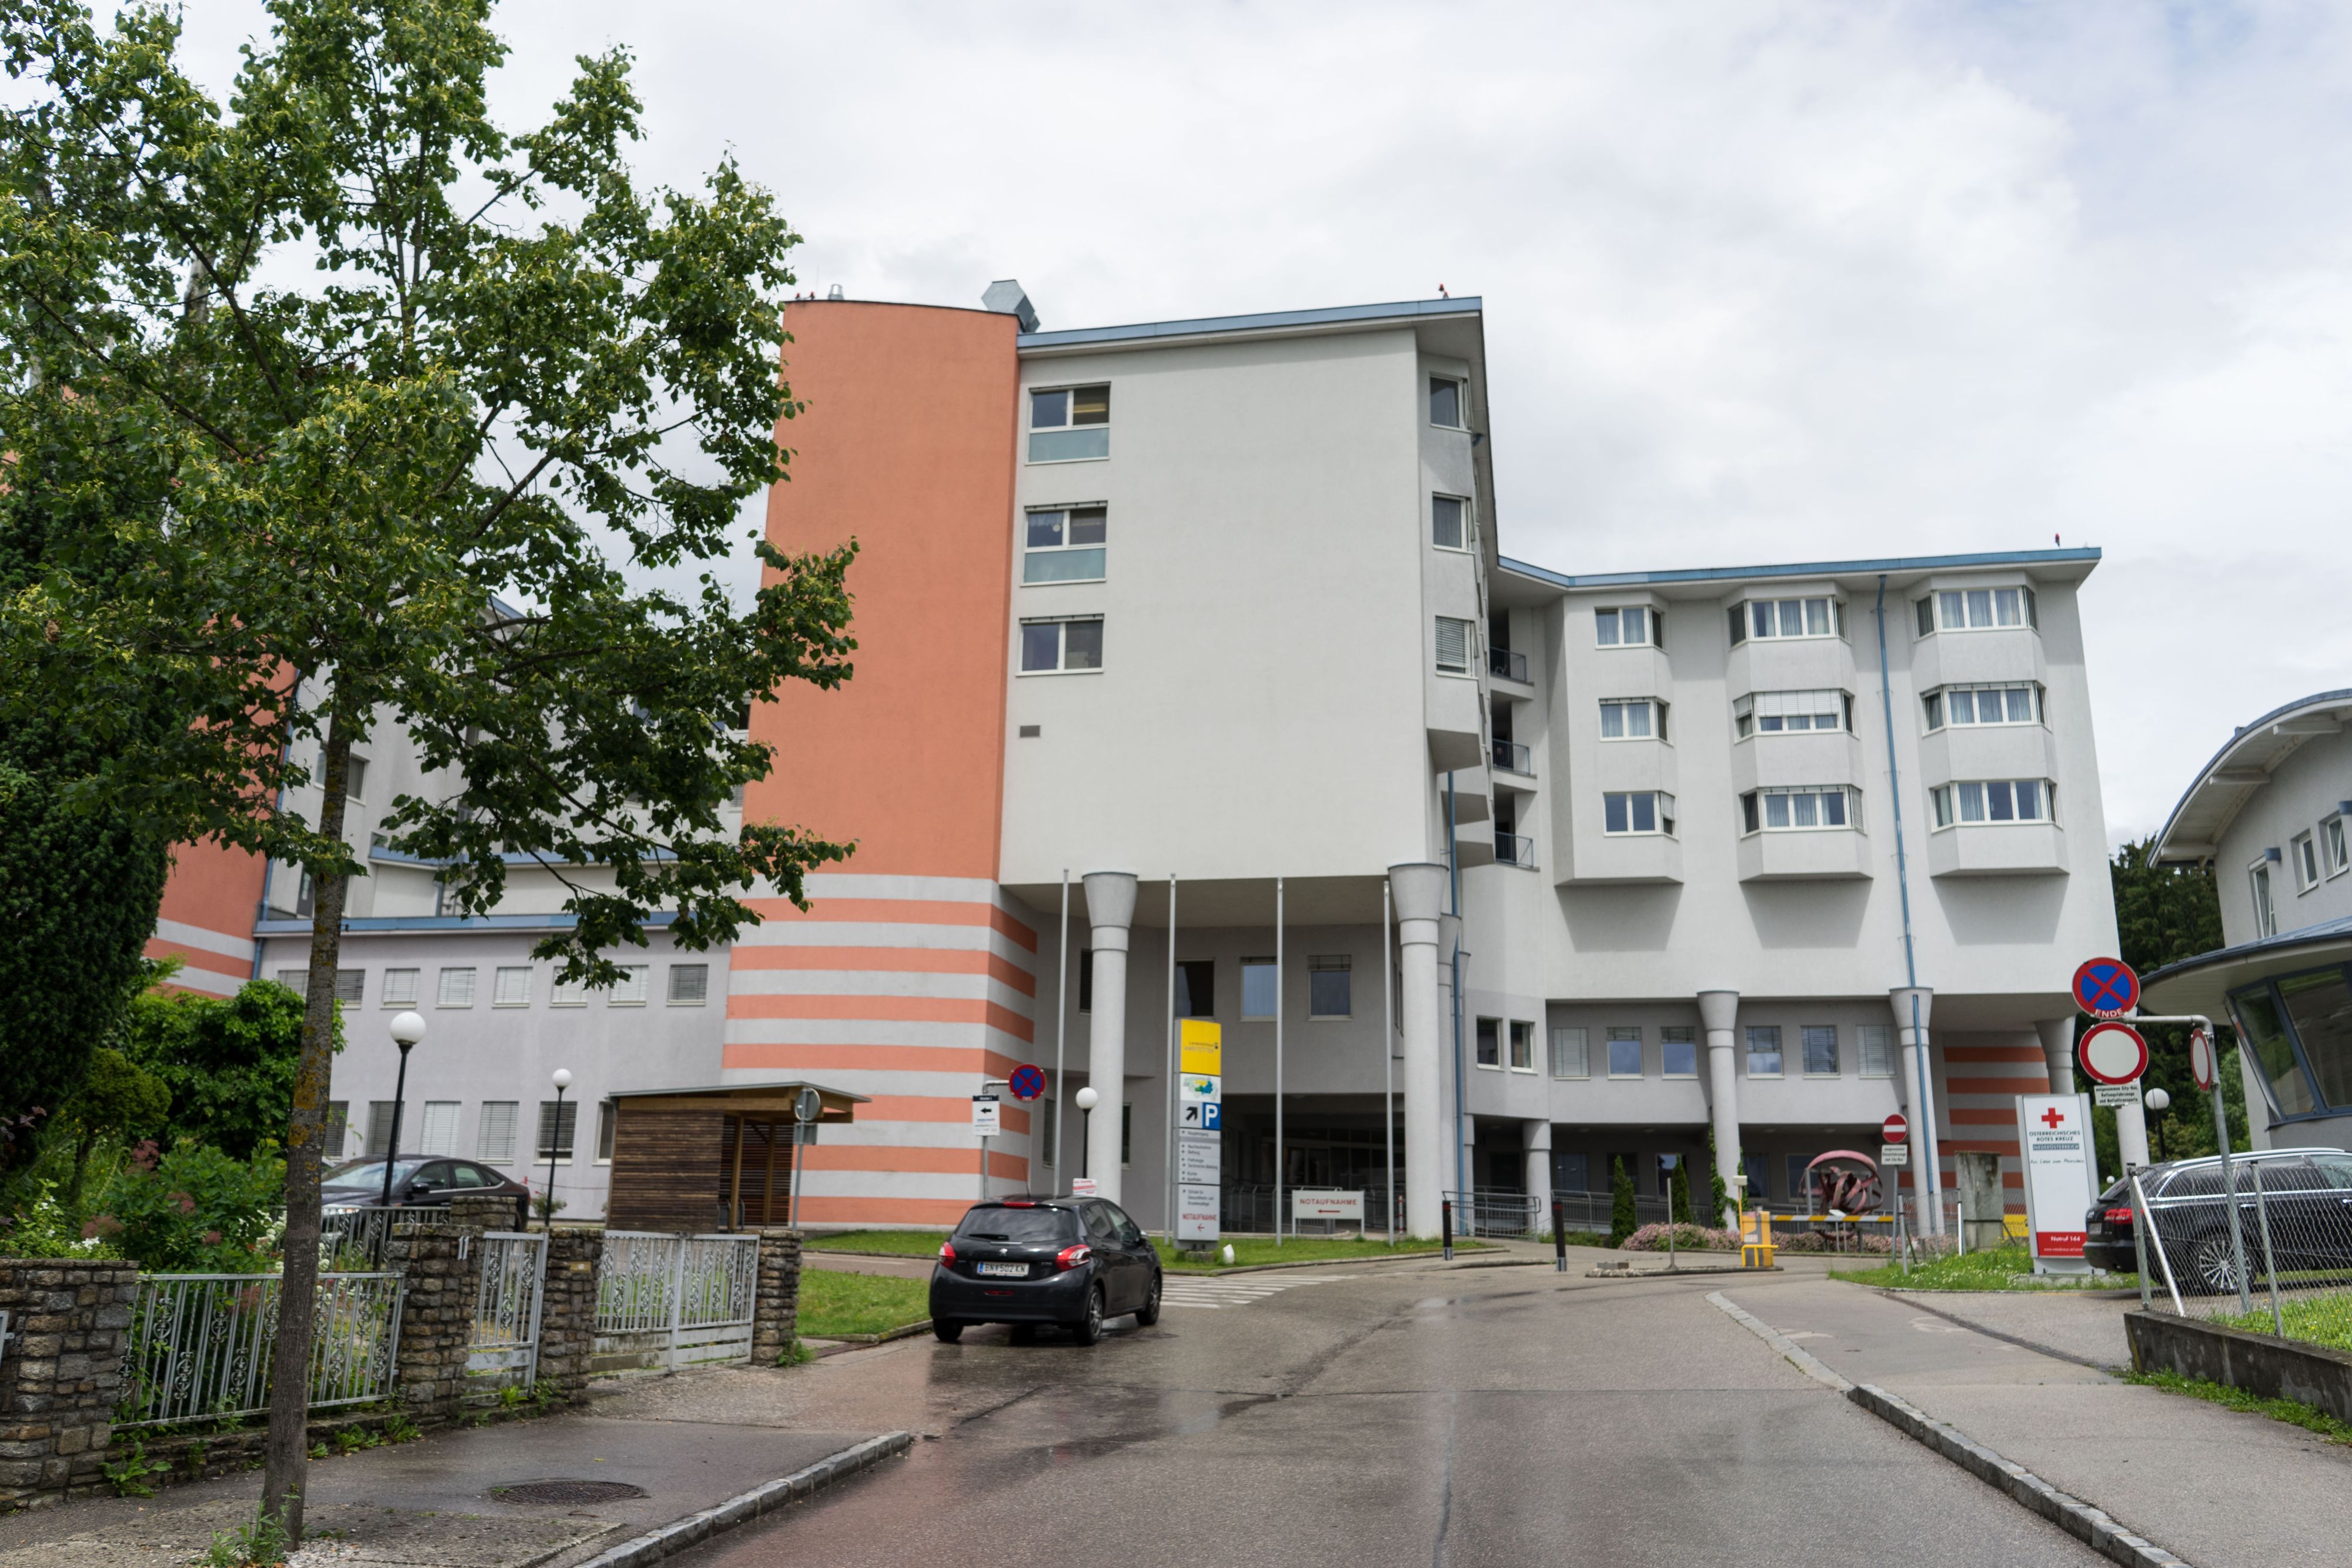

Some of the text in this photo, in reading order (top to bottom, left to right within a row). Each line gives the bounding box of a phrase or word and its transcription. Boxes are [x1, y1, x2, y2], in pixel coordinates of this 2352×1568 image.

[2095, 1008, 2123, 1017] ENDE
[1182, 1213, 1217, 1221] NOTAUFNAHME
[984, 1263, 1025, 1273] BN 502 KN
